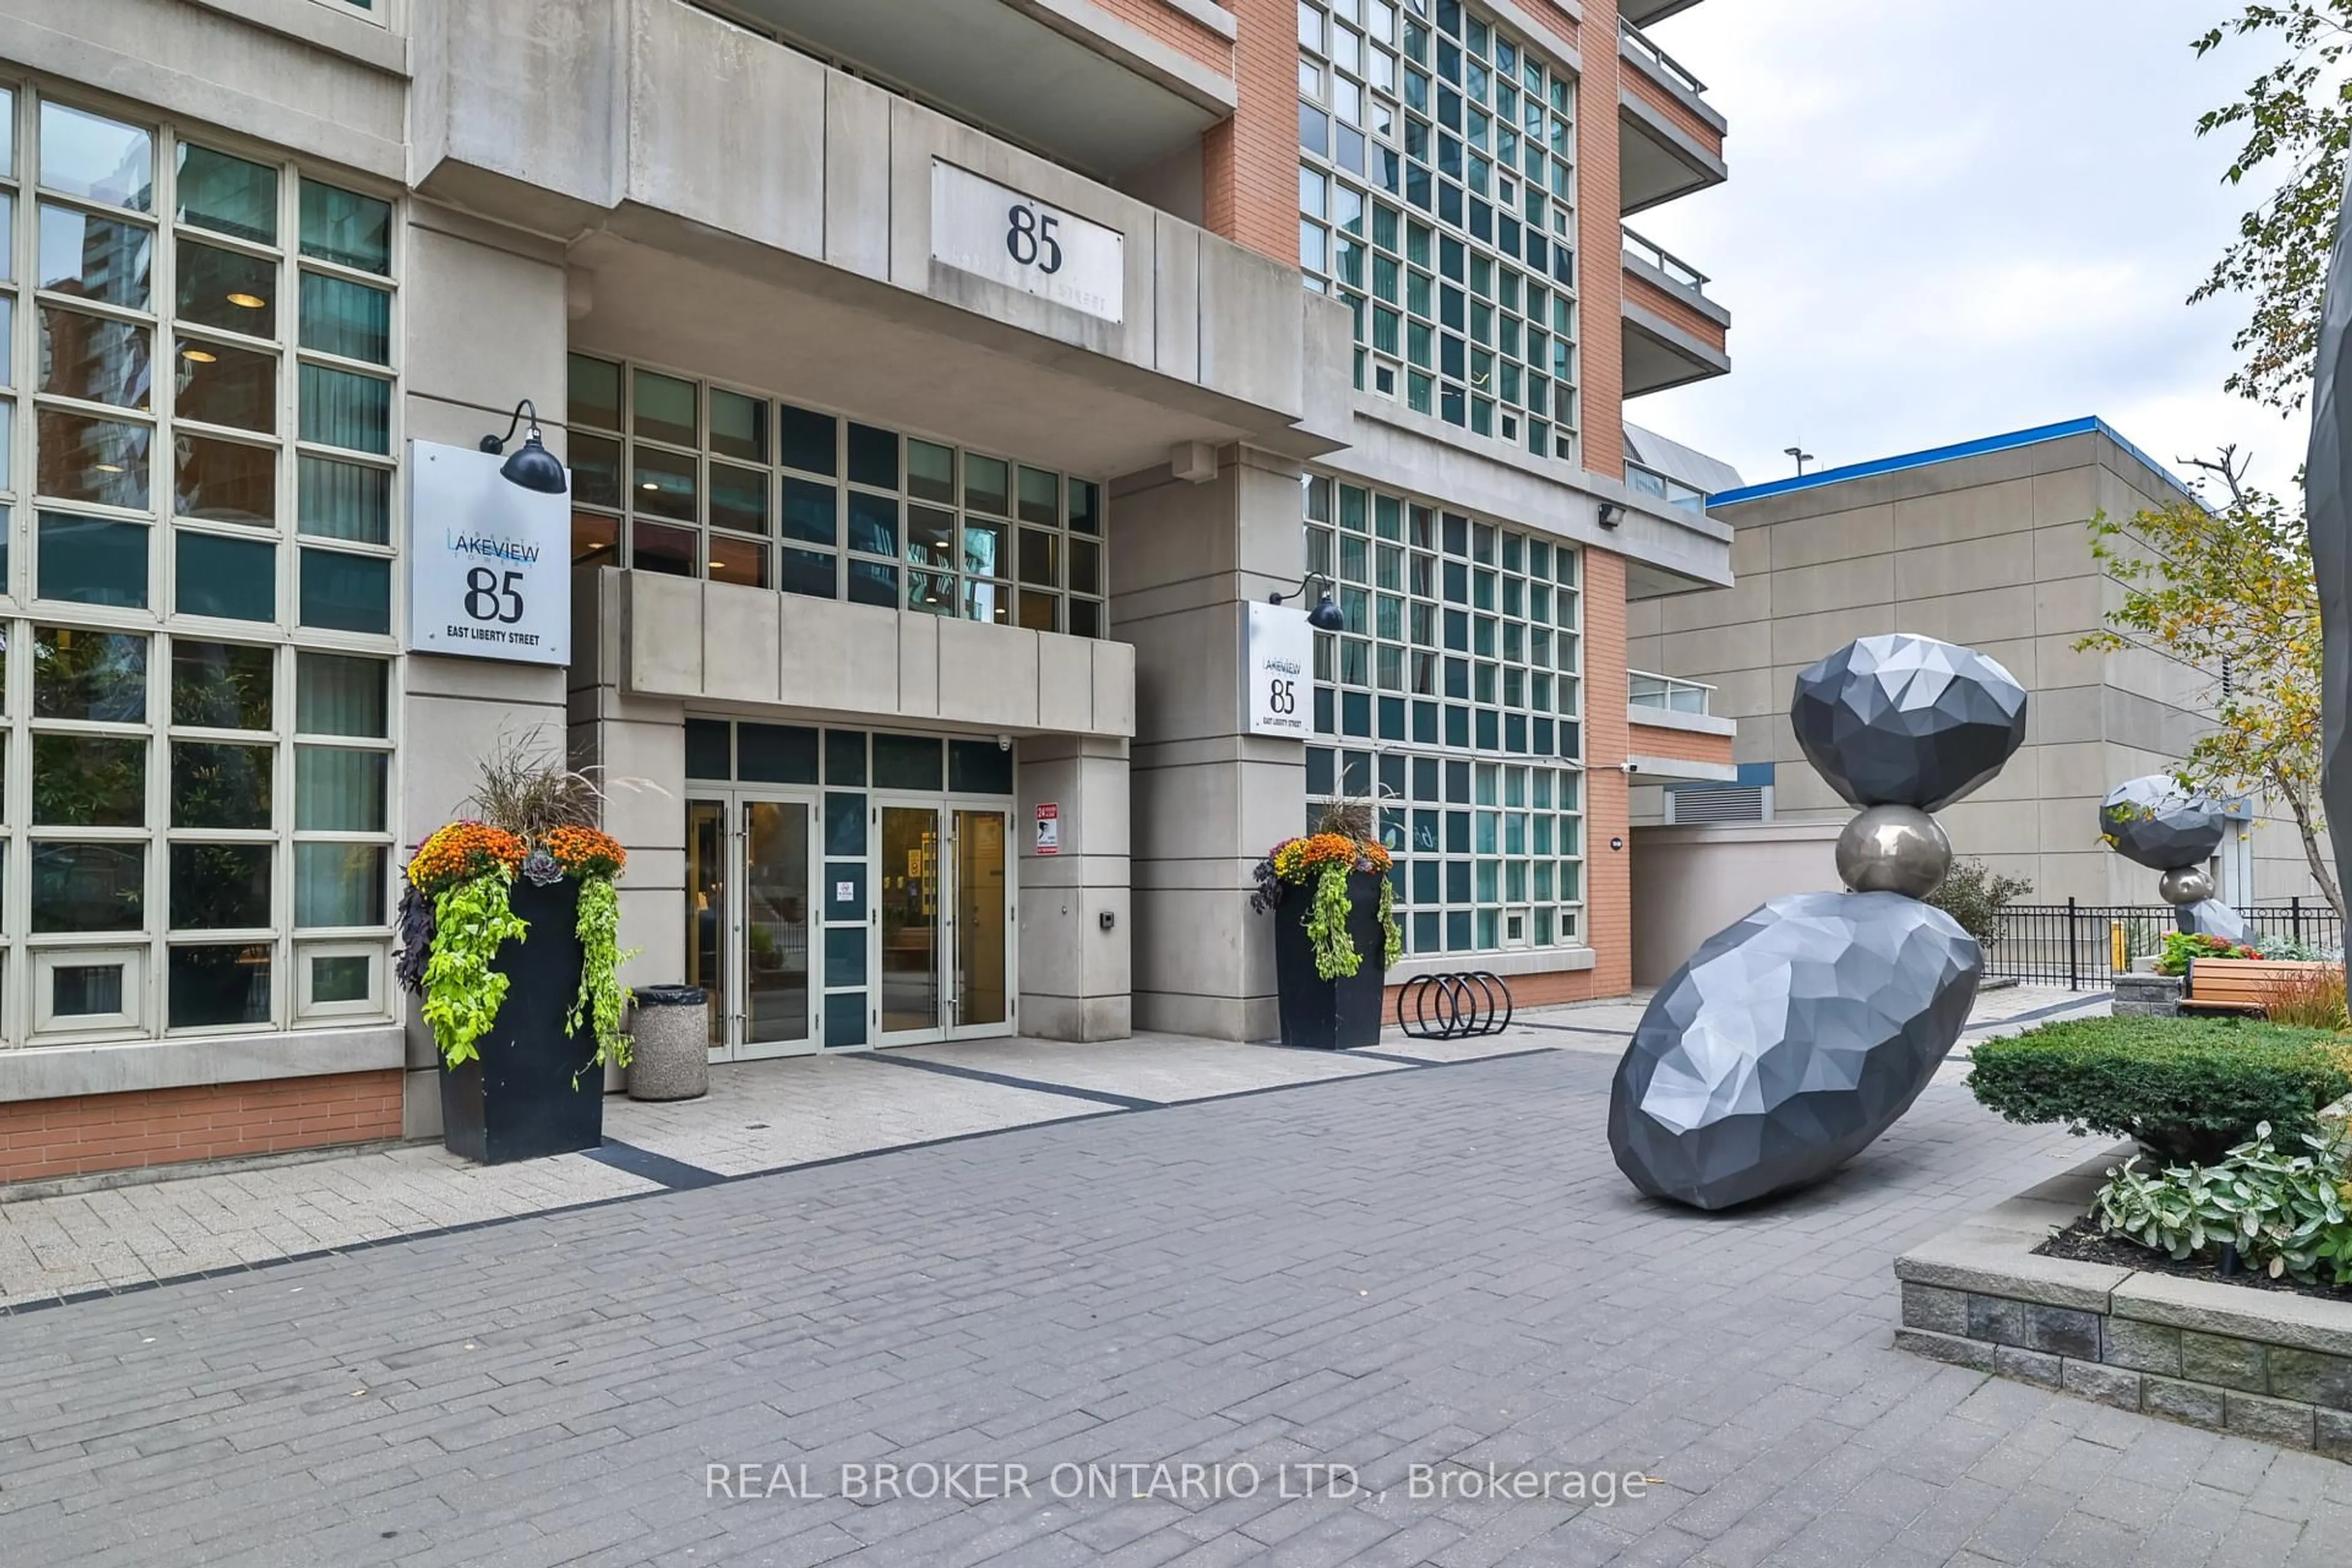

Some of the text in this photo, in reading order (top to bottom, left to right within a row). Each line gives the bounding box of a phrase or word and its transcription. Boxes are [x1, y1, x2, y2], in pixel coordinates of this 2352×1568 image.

[1007, 205, 1061, 274] 85
[464, 567, 524, 624] 85
[447, 625, 540, 646] EAST LIBERTY STREET
[1270, 679, 1295, 714] 85
